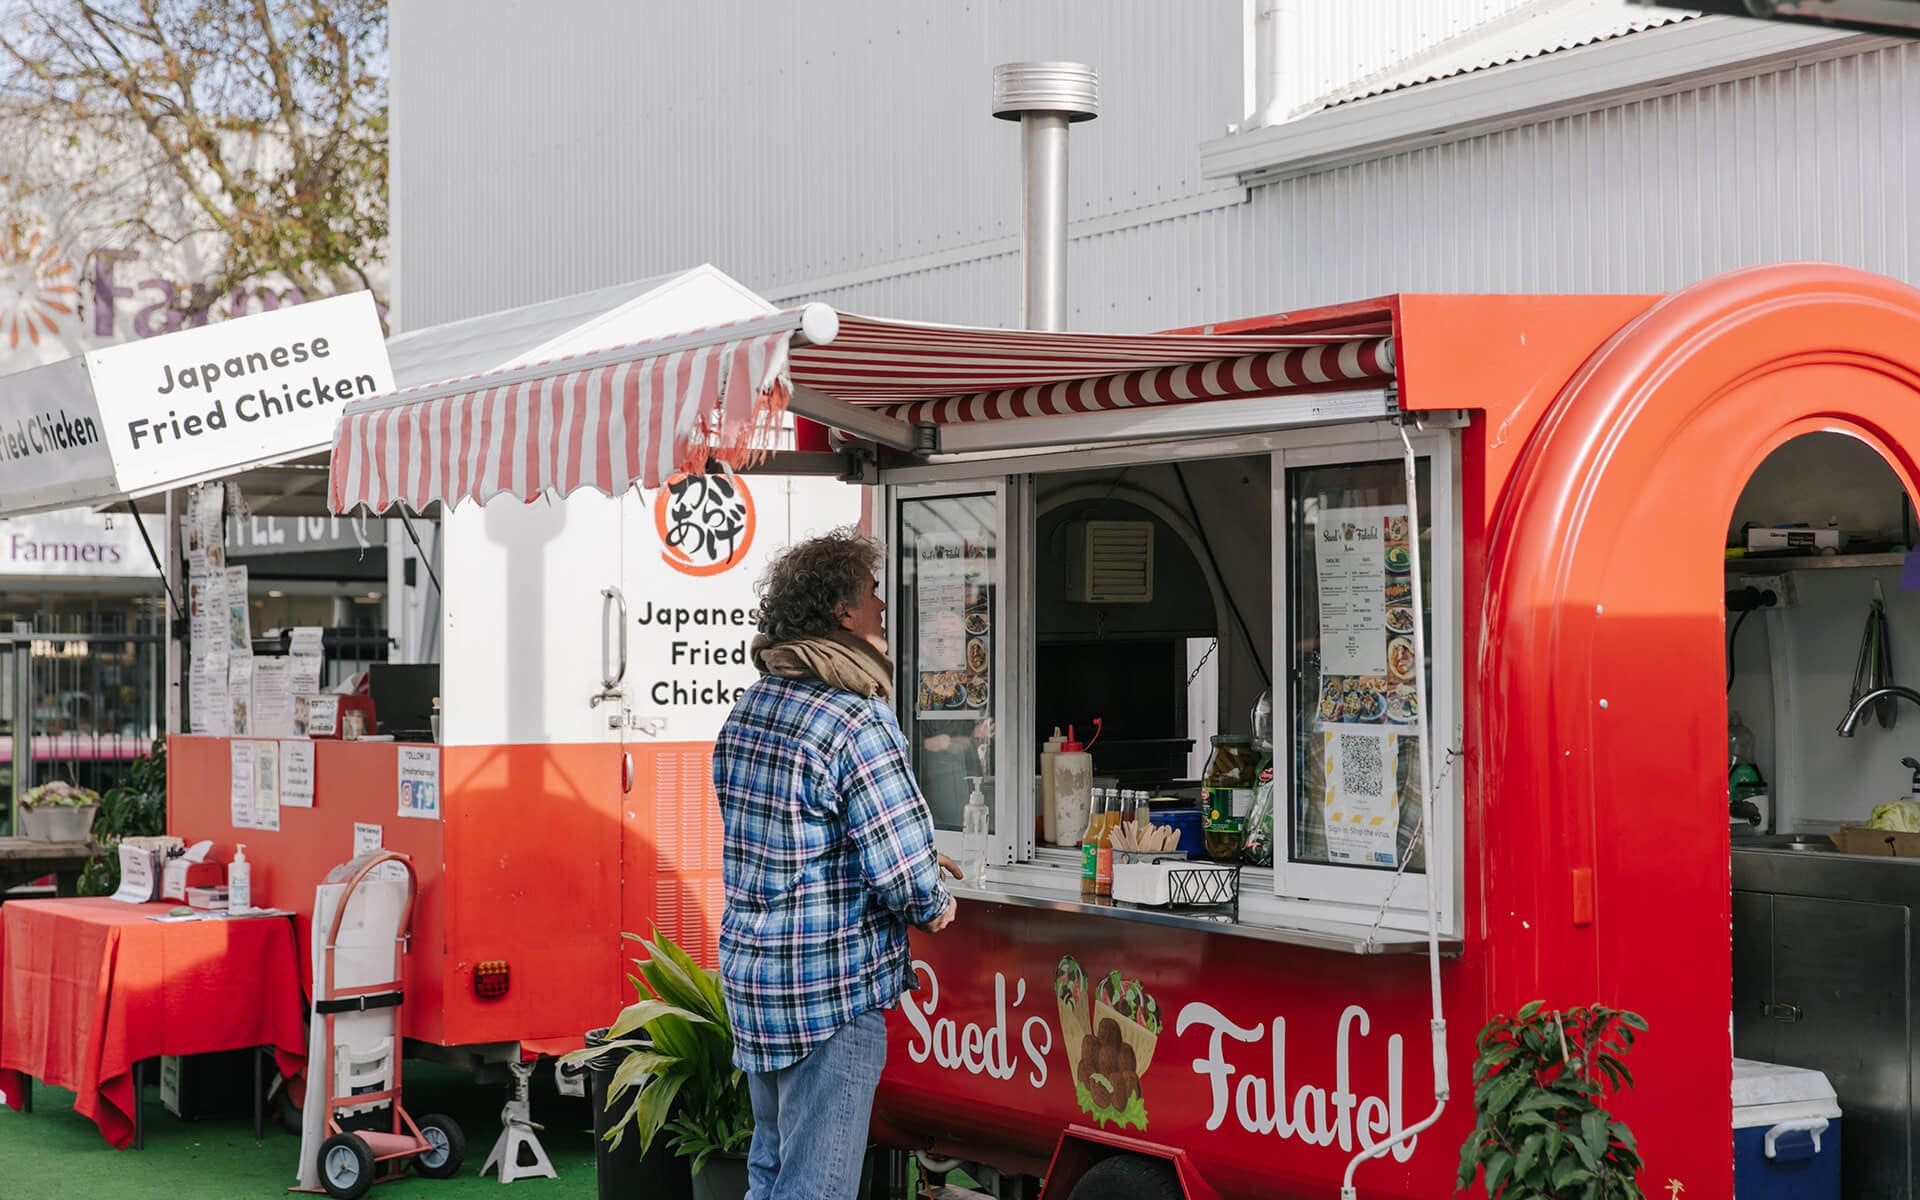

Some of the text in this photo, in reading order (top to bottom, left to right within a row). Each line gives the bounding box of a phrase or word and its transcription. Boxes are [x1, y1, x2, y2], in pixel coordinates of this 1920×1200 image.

[94, 247, 389, 338] Farm
[157, 336, 331, 395] Japanese
[28, 409, 99, 455] Chicken
[128, 373, 377, 450] Fried Chicken
[11, 534, 120, 562] Farmers
[638, 600, 759, 633] Japanes
[671, 640, 746, 665] Fried
[651, 679, 746, 706] Chicke
[901, 959, 1418, 1163] Saed's Falafel
